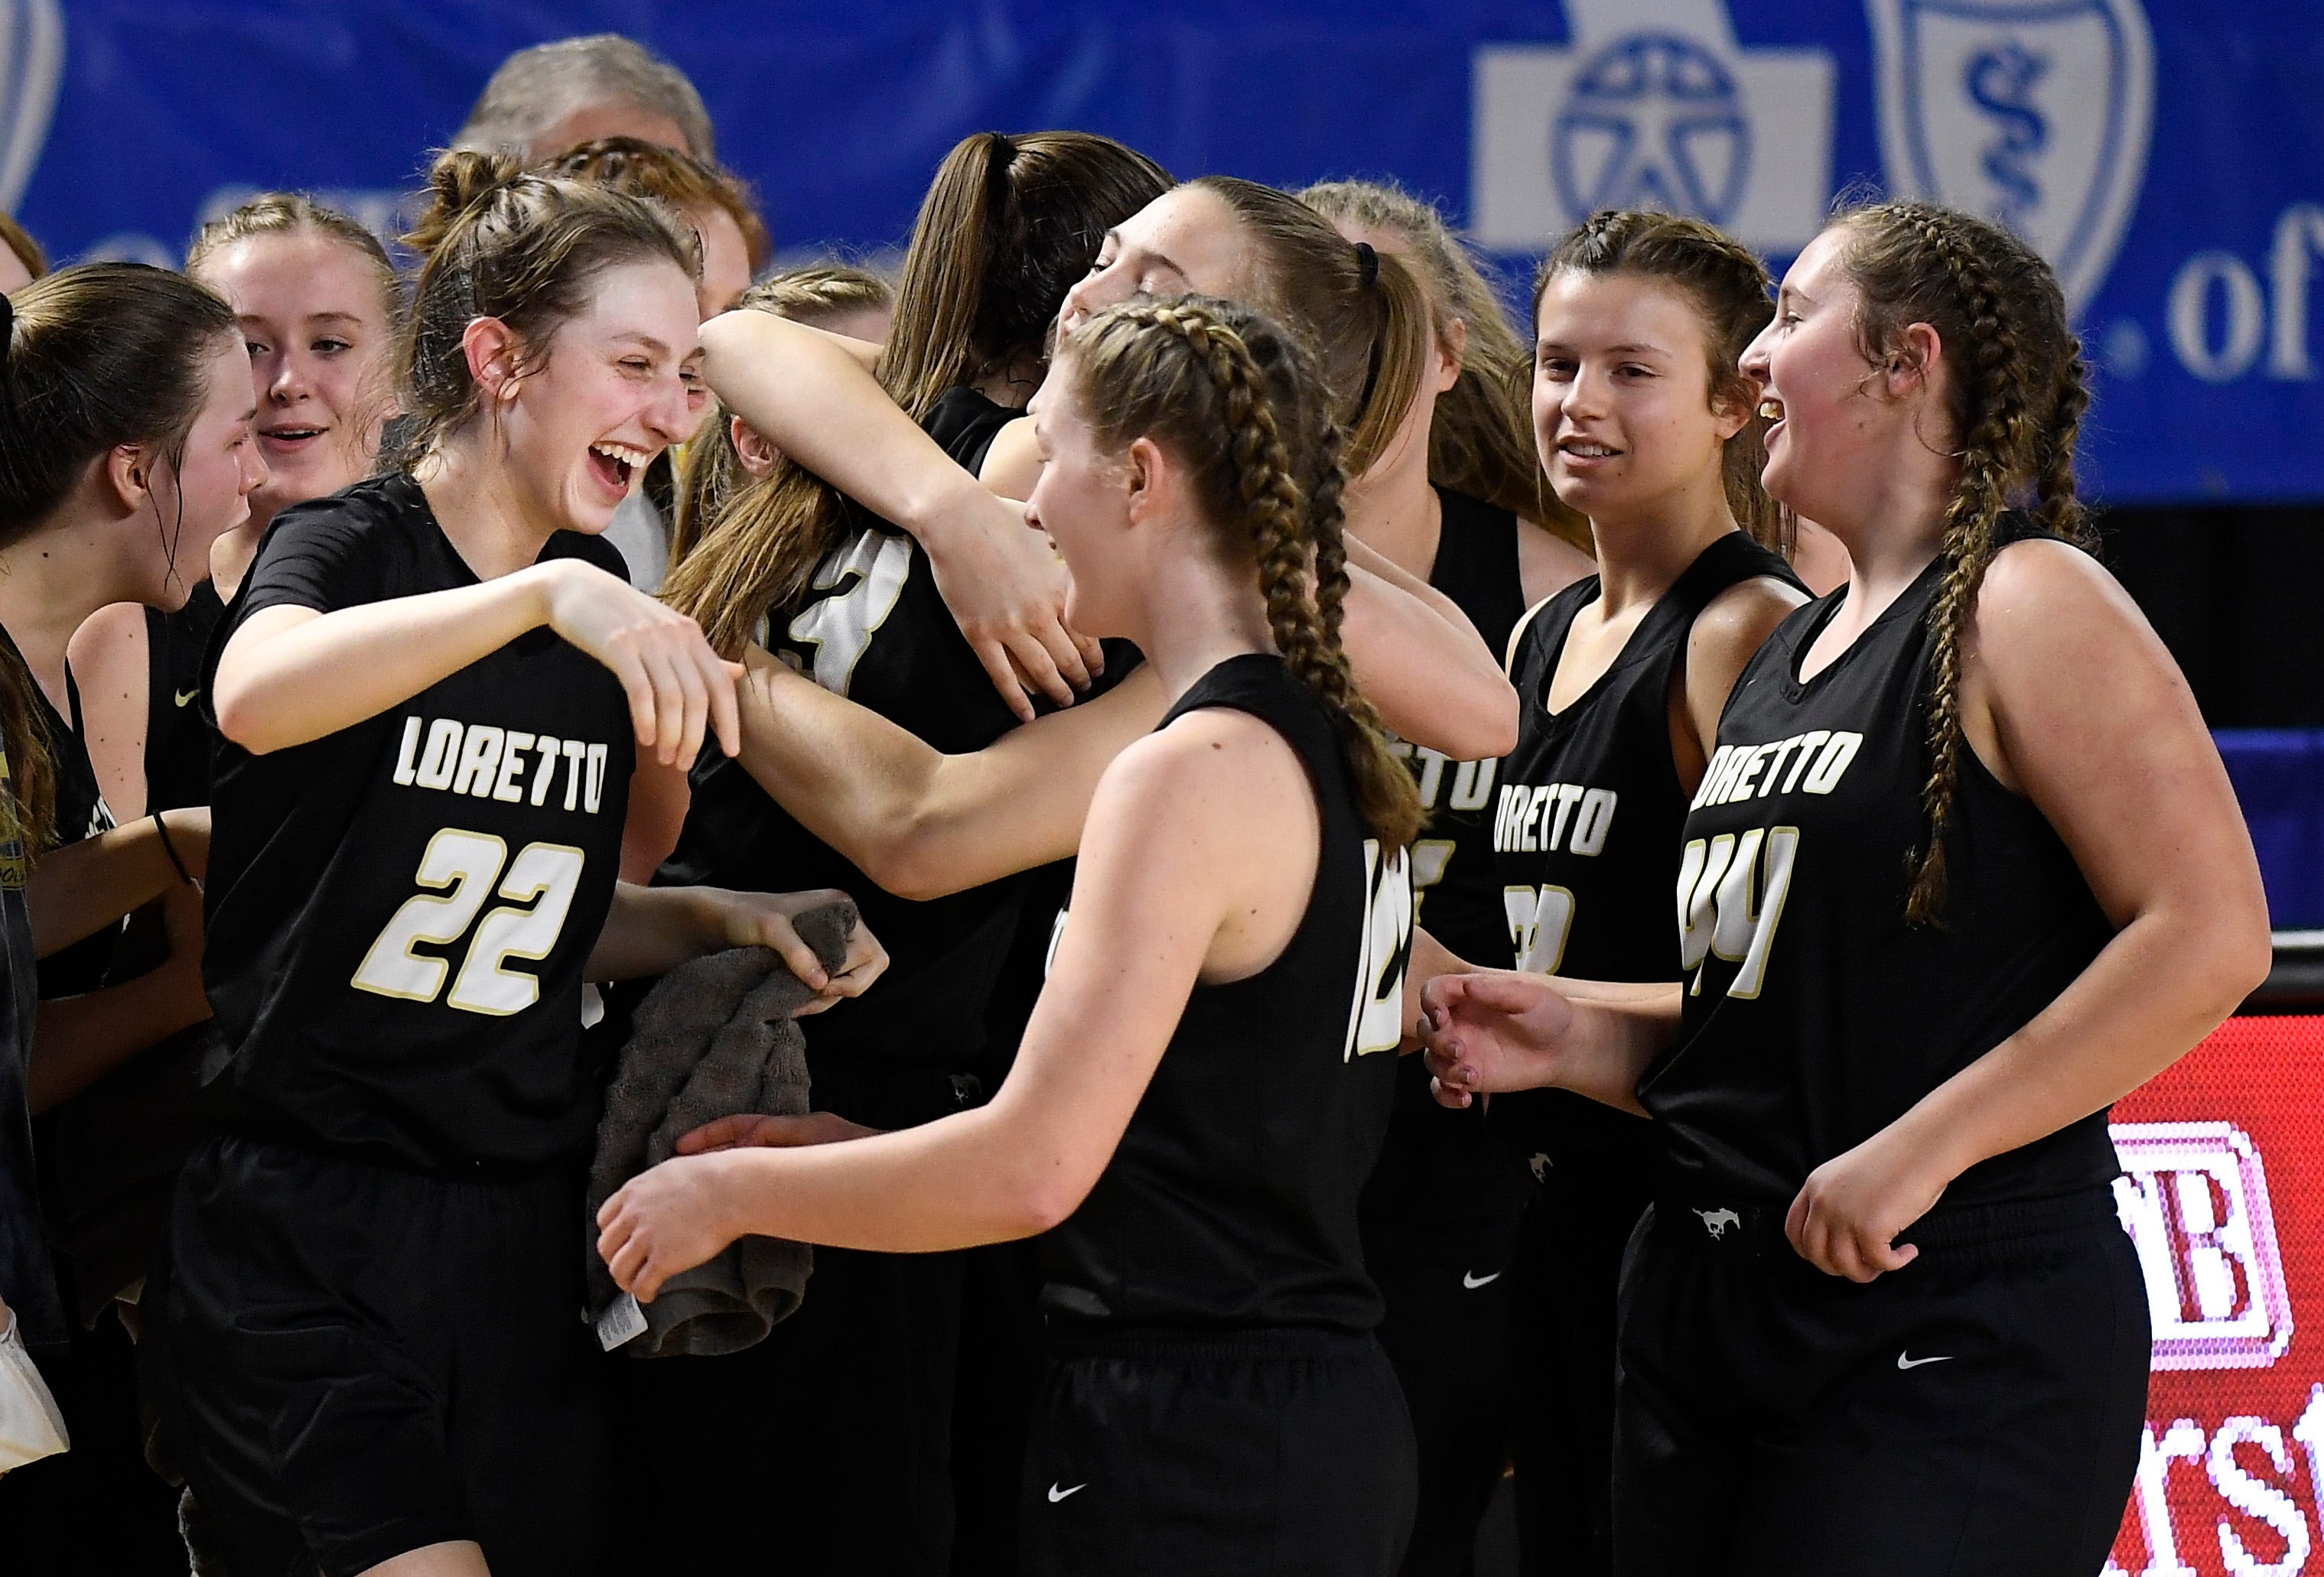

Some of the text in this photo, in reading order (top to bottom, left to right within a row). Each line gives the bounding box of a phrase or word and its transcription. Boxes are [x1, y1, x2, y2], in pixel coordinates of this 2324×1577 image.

[392, 716, 608, 814] LORETTO
[1690, 730, 1863, 812] ORETTO
[1494, 783, 1618, 857] ORETTO
[350, 827, 584, 1016] 22
